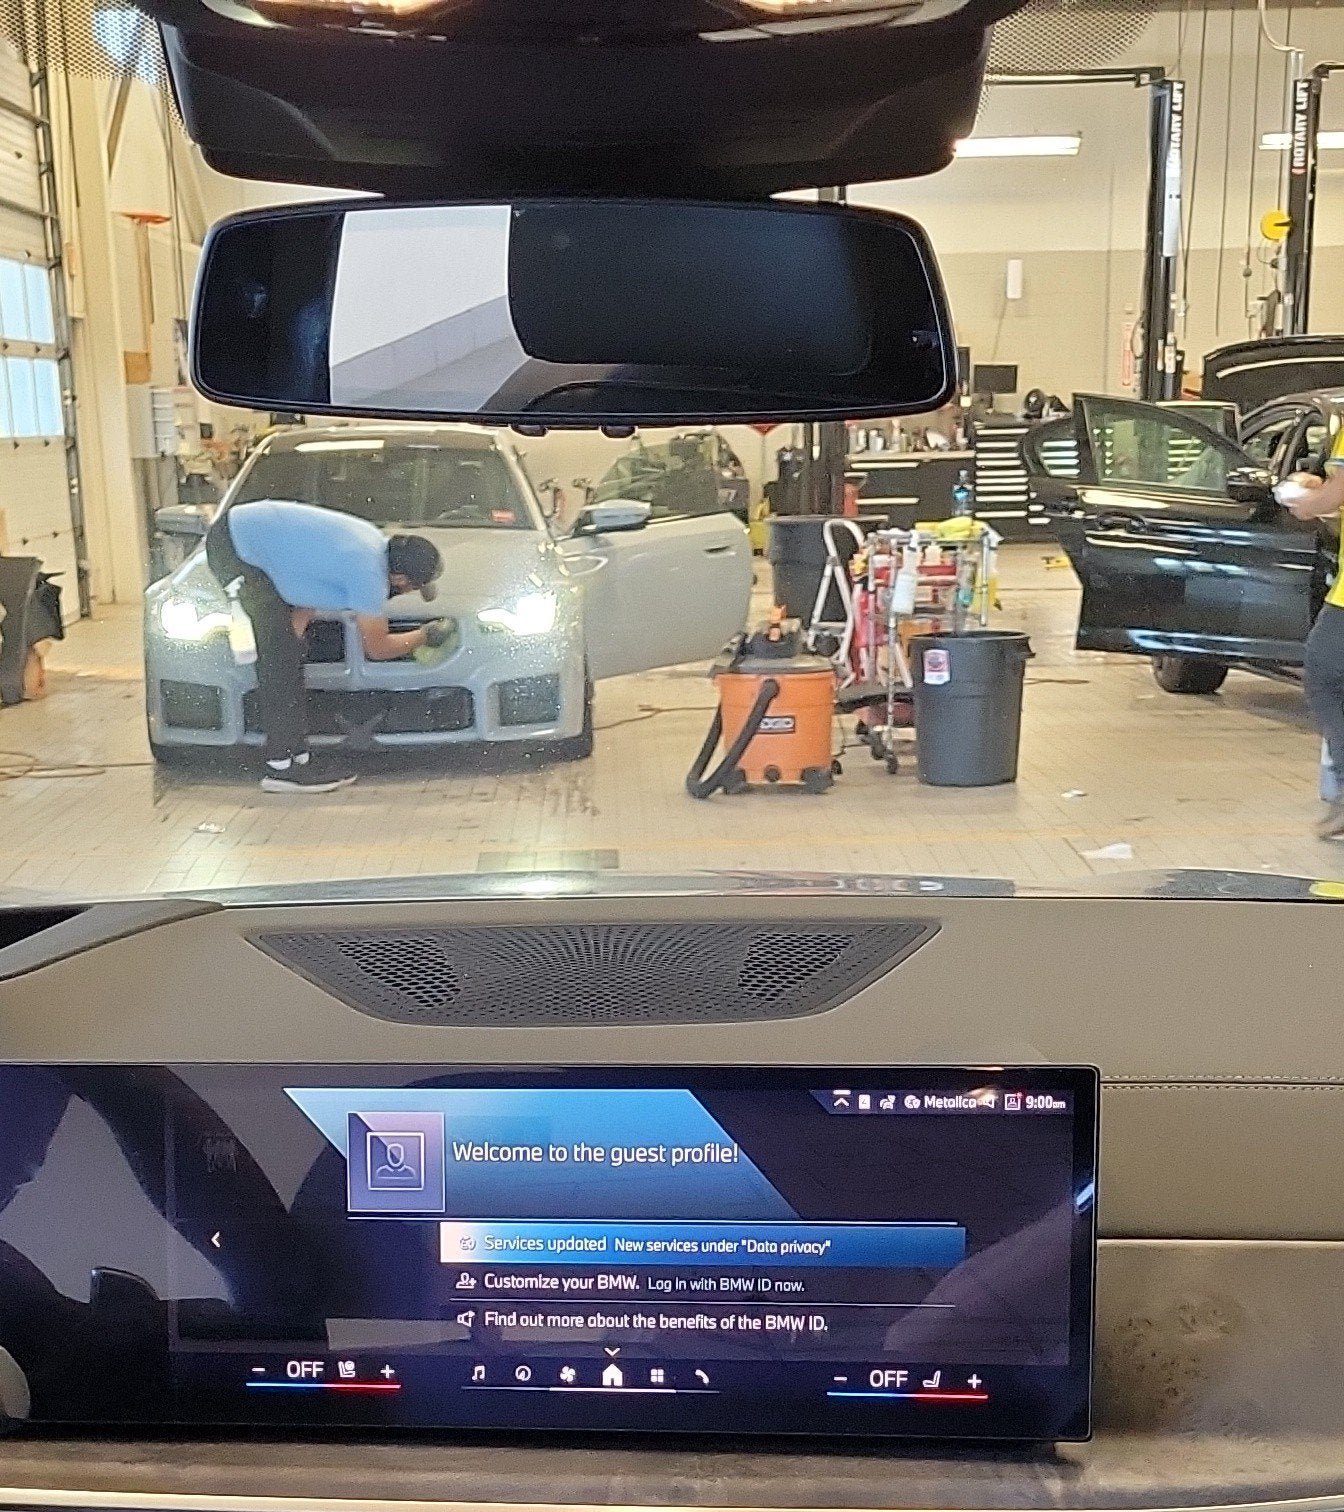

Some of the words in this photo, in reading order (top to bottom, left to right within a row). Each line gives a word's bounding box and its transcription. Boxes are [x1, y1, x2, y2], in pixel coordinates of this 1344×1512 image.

[1296, 81, 1309, 110] LIFT
[453, 1142, 544, 1162] Welcome
[549, 1144, 568, 1162] to
[573, 1143, 605, 1163] the
[611, 1146, 666, 1166] guest
[671, 1142, 739, 1167] profile!
[484, 1235, 544, 1251] Services
[547, 1236, 607, 1254] updated
[615, 1238, 644, 1252] New
[646, 1238, 699, 1253] services
[701, 1239, 739, 1253] under
[741, 1239, 777, 1253] "Data
[780, 1239, 831, 1256] privacy"
[484, 1273, 559, 1289] Customize
[562, 1275, 594, 1293] your
[598, 1274, 640, 1290] BMW.
[648, 1277, 672, 1293] Log
[690, 1277, 717, 1291] with
[720, 1278, 755, 1291] BMW
[758, 1278, 772, 1291] ID
[775, 1281, 805, 1292] now.
[484, 1312, 516, 1327] Find
[520, 1313, 544, 1328] out
[547, 1315, 584, 1328] more
[587, 1312, 630, 1329] about
[633, 1313, 656, 1329] the
[660, 1314, 717, 1330] benefits
[720, 1314, 735, 1330] of
[738, 1314, 761, 1330] the
[765, 1315, 805, 1331] BMW
[808, 1316, 829, 1331] ID.
[286, 1361, 324, 1379] OFF
[869, 1370, 908, 1388] OFF
